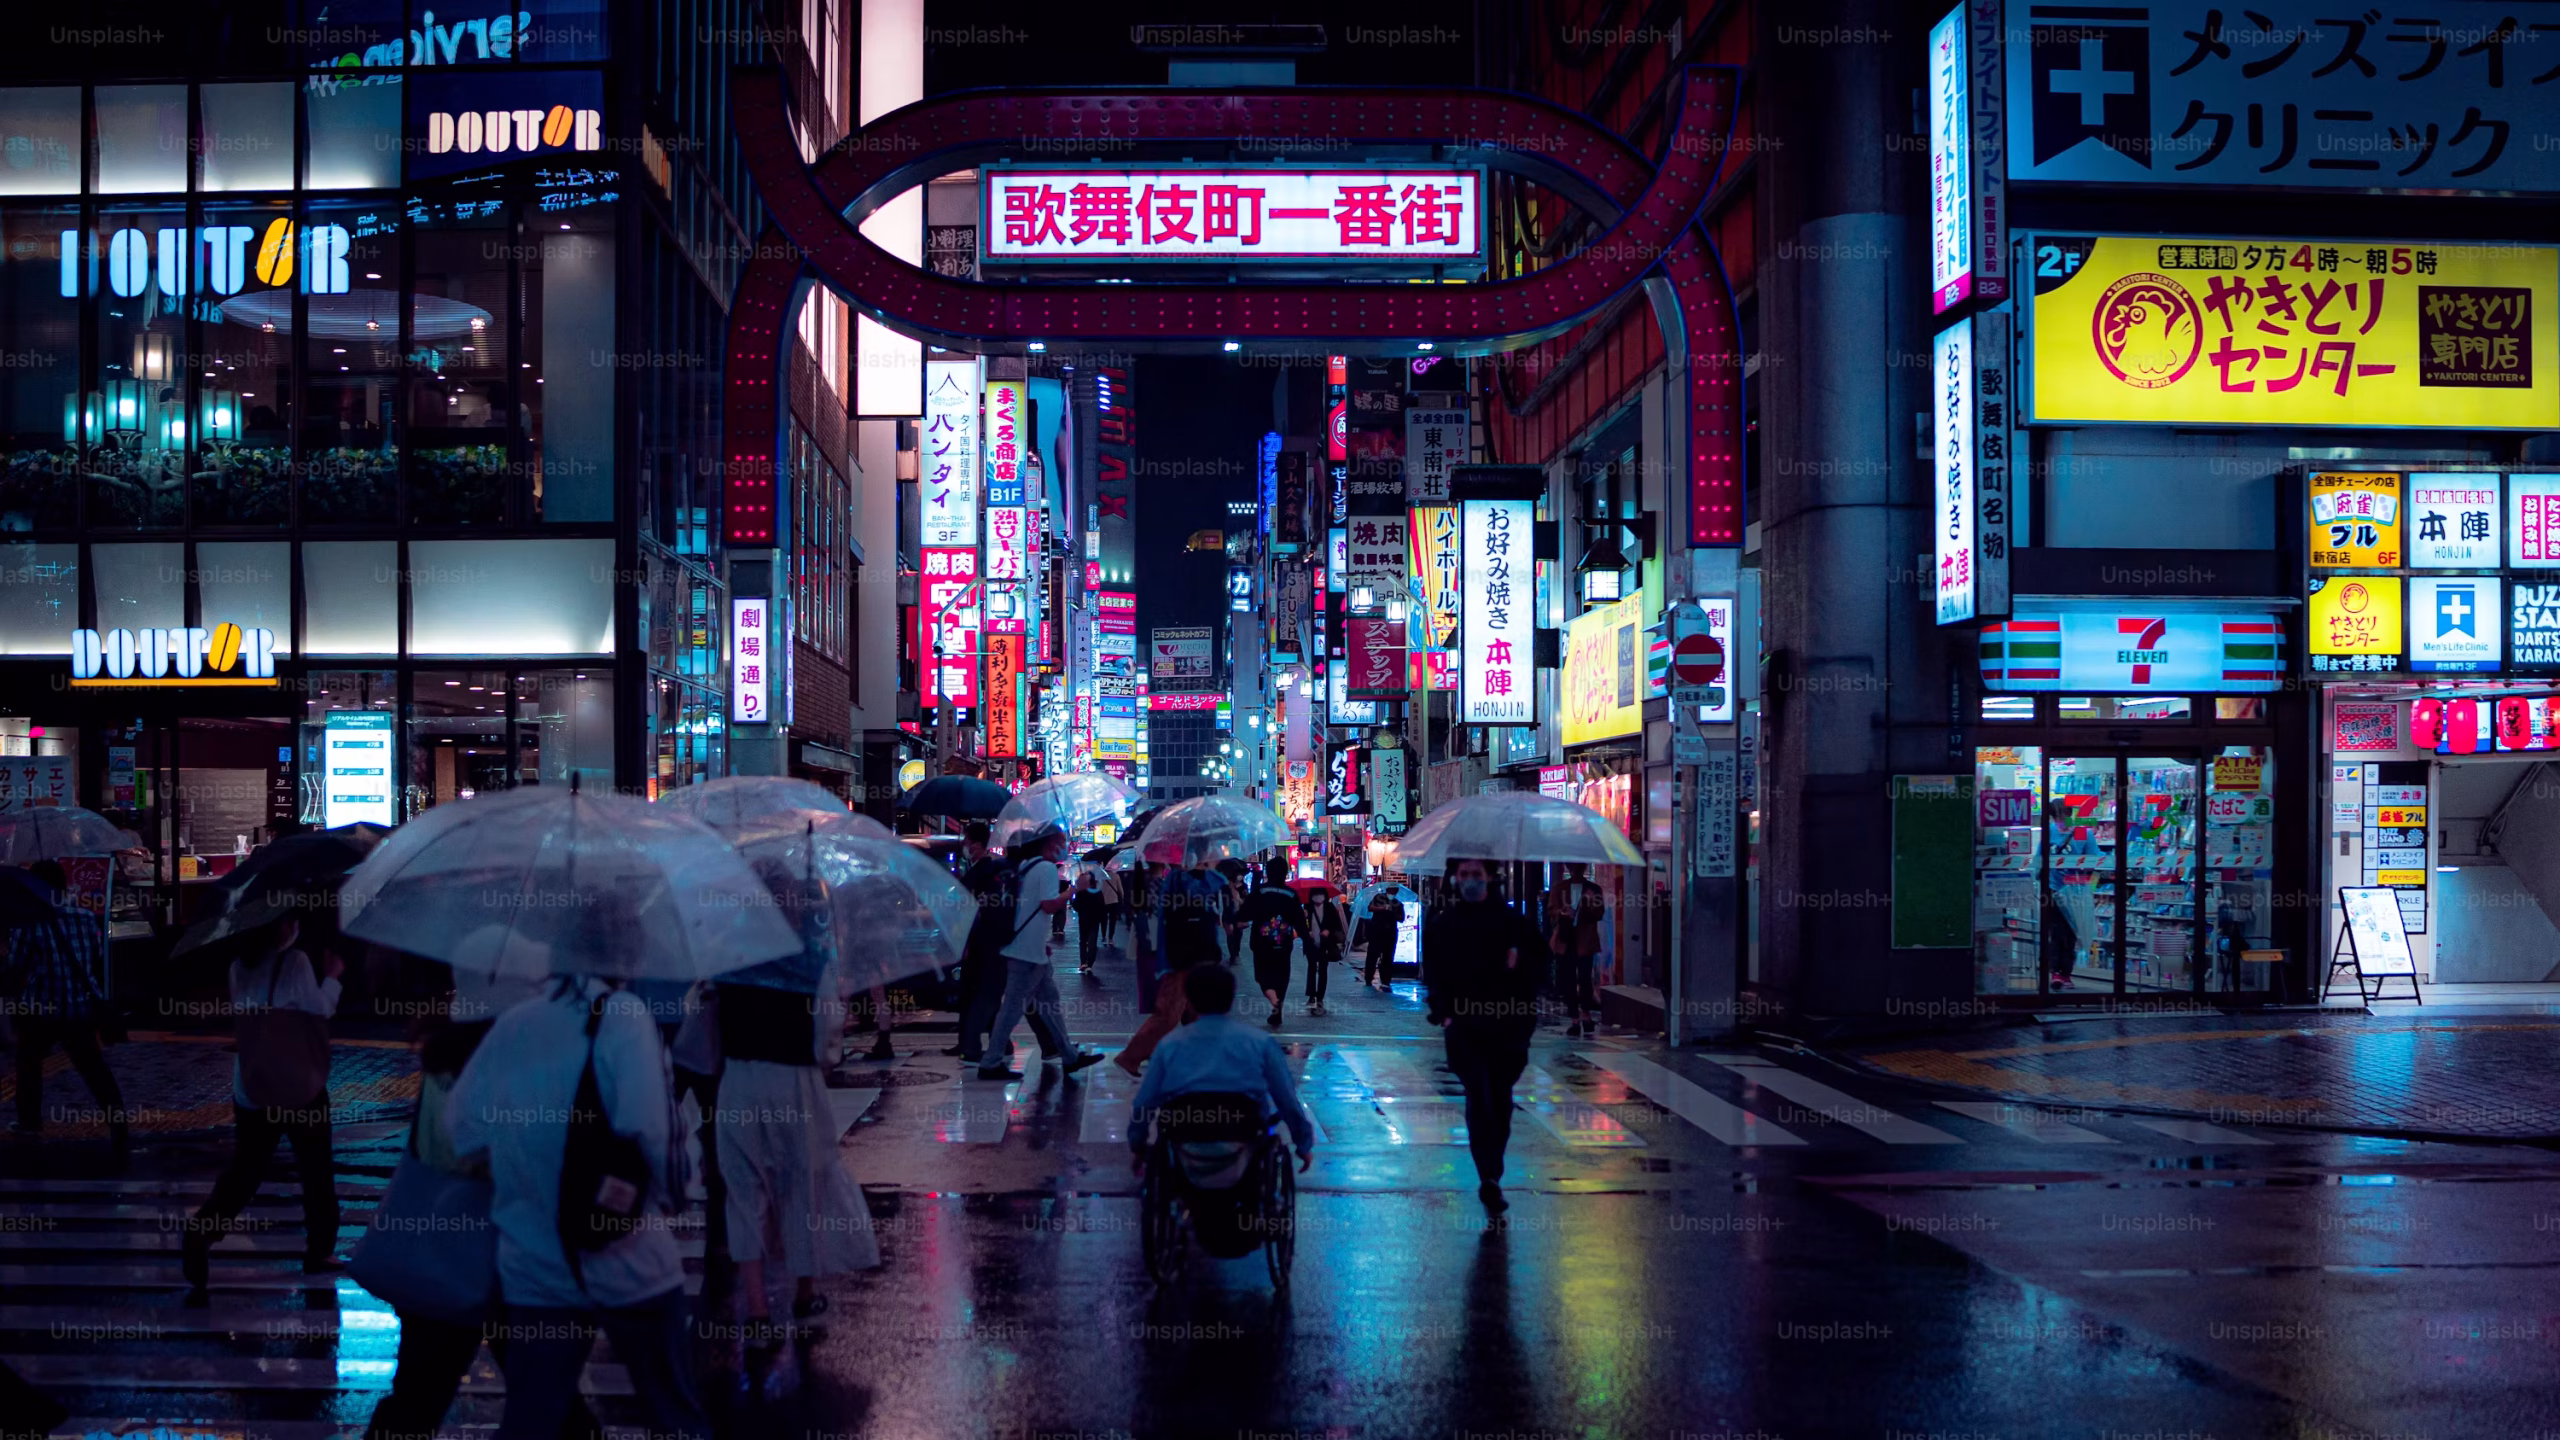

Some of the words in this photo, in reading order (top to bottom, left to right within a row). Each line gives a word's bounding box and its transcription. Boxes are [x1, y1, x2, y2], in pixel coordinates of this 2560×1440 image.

[1974, 24, 2002, 193] ファイトフィット
[429, 104, 600, 153] DOUTOR
[2169, 99, 2511, 178] クリニック
[1003, 182, 1463, 247] 歌舞伎町一番街
[2036, 245, 2080, 278] 2F
[2160, 246, 2237, 270] 営業時間
[1978, 281, 2003, 295] B2F
[2110, 273, 2151, 292] YAKITORI
[2151, 274, 2184, 294] CENTER
[2204, 276, 2386, 336] やきとり
[2426, 293, 2526, 331] やきとり
[2430, 333, 2519, 371] 専門店
[2212, 336, 2397, 398] センター
[2433, 371, 2481, 382] YAKITORI
[2482, 371, 2520, 382] CENTER
[2124, 375, 2149, 388] SINCE
[993, 386, 1019, 482] まぐろ商店
[928, 413, 956, 509] バンタイ
[1423, 427, 1444, 496] 東南荘
[1981, 368, 2005, 560] 歌舞伎町名物
[2313, 475, 2396, 488] 全国チェーンの店
[990, 487, 1022, 502] B1F
[2336, 492, 2373, 515] 麻雀
[938, 531, 959, 542] 3F
[2330, 523, 2379, 549] ブル
[2418, 510, 2491, 542] 本陣
[2522, 497, 2540, 558] お好み焼
[1436, 511, 1457, 610] ハイボール
[2313, 551, 2351, 565] 新宿店
[2378, 551, 2397, 565] 6F
[2435, 545, 2473, 559] HONJIN
[923, 552, 975, 576] 焼肉
[1486, 507, 1511, 630] お好み焼き
[2310, 579, 2325, 591] 2F
[2514, 585, 2560, 607] BUZ
[1287, 573, 1297, 639] SLUSH
[996, 620, 1017, 632] 4F
[2329, 616, 2377, 632] やきとり
[72, 622, 276, 678] DOUTOR
[2331, 632, 2380, 648] センター
[2423, 642, 2447, 651] Men's
[2448, 642, 2464, 651] Life
[2465, 642, 2488, 651] Clinic
[740, 608, 761, 713] 劇場通り
[1364, 621, 1393, 687] ステップ
[2312, 655, 2397, 671] 朝まで営業中
[1485, 639, 1513, 697] 本陣
[2465, 662, 2477, 671] 3F
[1434, 674, 1457, 688] 2F
[1473, 701, 1525, 718] HONJIN
[2215, 757, 2262, 767] ATM
[1384, 755, 1404, 815] お好み焼き
[1983, 798, 2030, 821] SIM
[2208, 798, 2247, 816] たばこ
[2253, 798, 2270, 816] 酒
[1390, 824, 1406, 832] B1F
[2379, 835, 2405, 844] STAND
